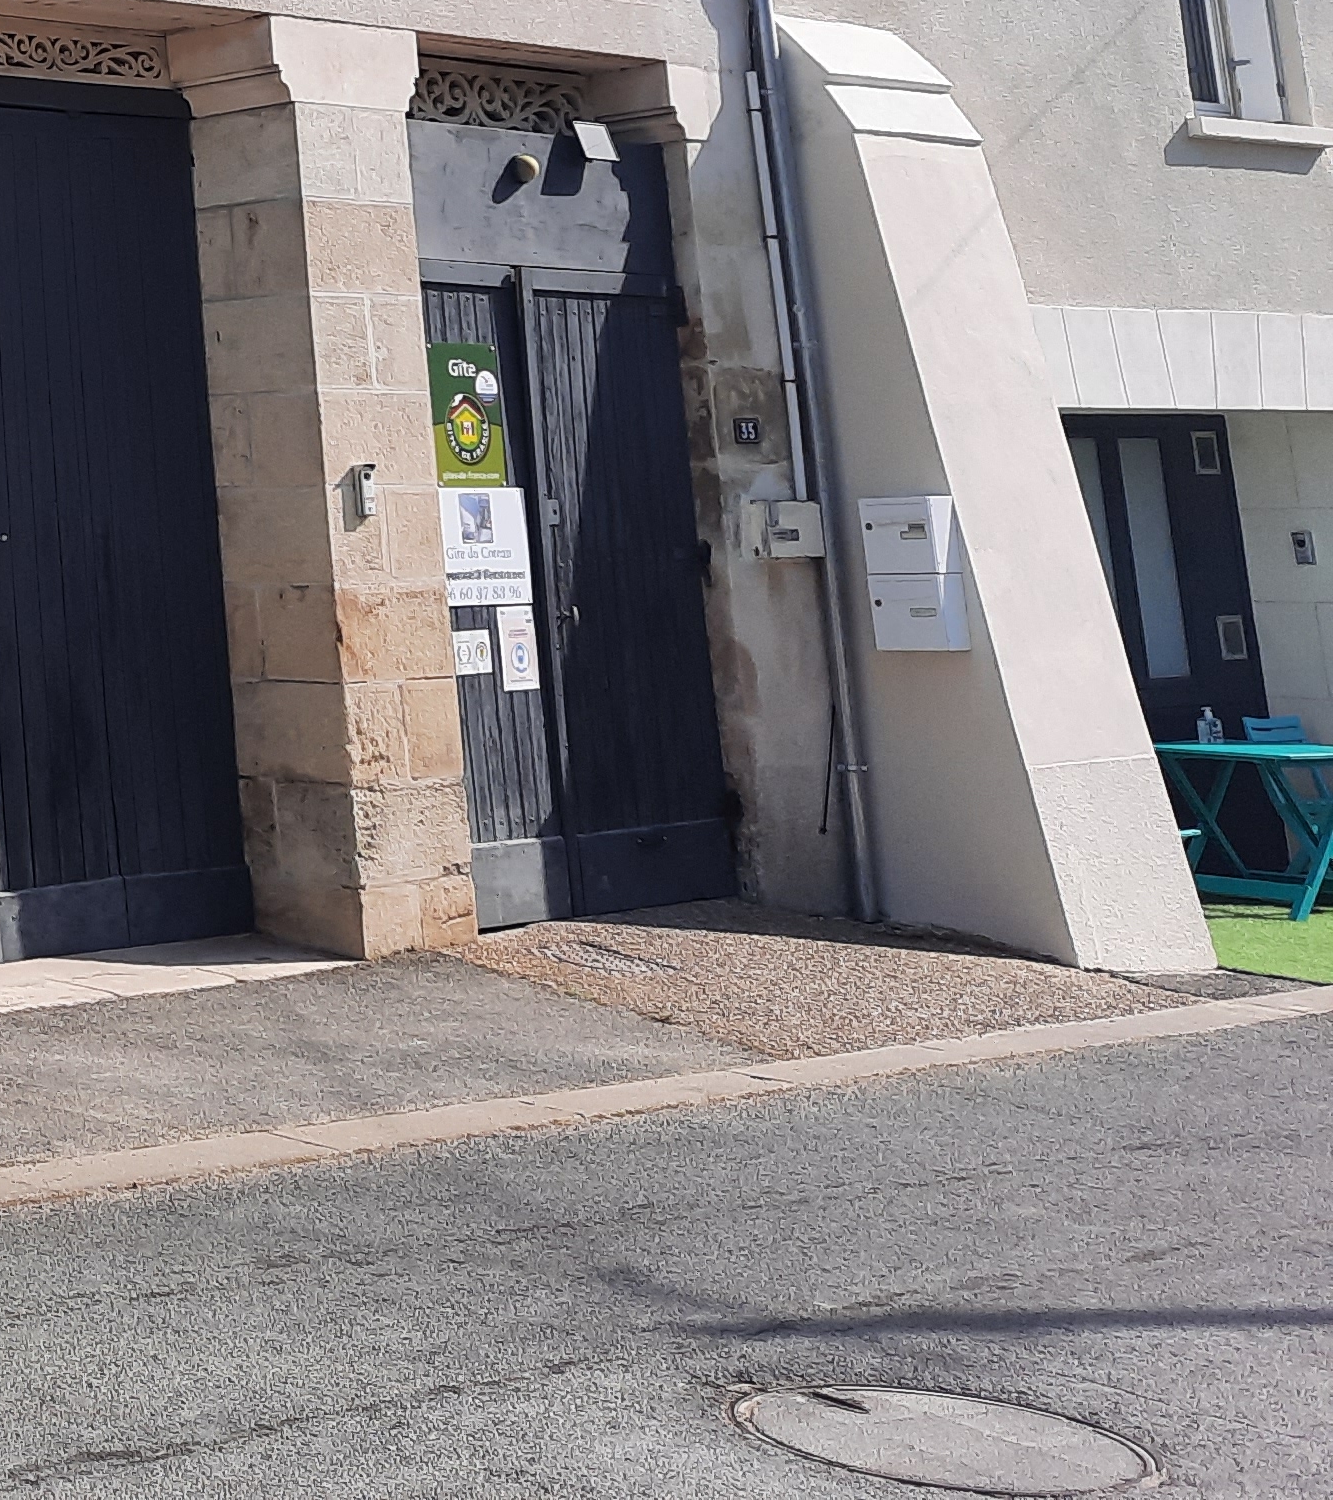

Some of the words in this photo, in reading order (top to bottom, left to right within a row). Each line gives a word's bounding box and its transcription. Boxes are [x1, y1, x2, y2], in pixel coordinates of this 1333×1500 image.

[739, 422, 756, 440] 35
[459, 586, 473, 601] 60
[509, 585, 522, 599] 96
